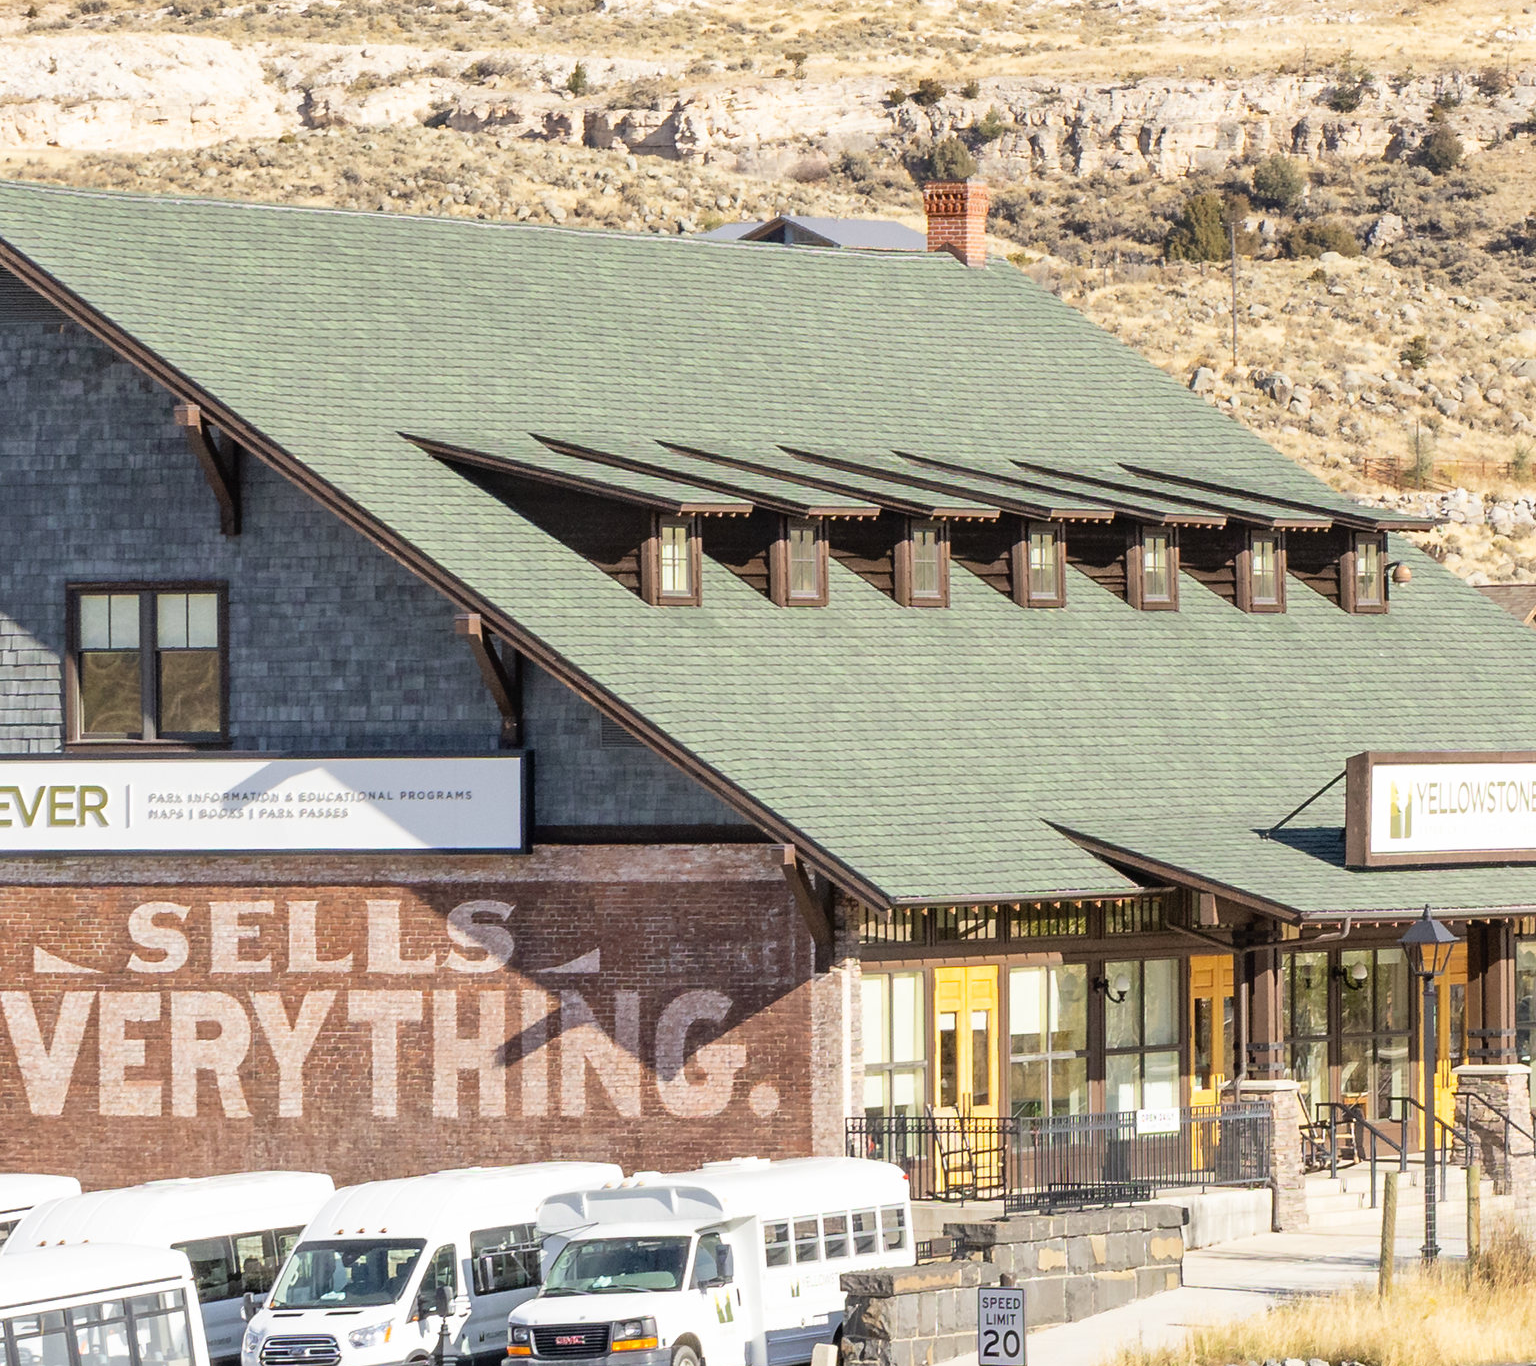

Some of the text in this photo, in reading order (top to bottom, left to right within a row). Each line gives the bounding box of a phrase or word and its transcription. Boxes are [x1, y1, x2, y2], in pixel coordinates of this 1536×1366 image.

[148, 792, 182, 803] PARK
[187, 791, 279, 803] INFORMATION
[298, 791, 394, 802] EDUCATIONAL
[399, 791, 473, 801] PROGRAMS
[148, 808, 349, 819] MAPS BOOKS PARK PASSES
[126, 899, 516, 974] SELLS
[982, 1297, 1021, 1309] SPEED
[986, 1313, 1016, 1325] LIMIT
[555, 1335, 585, 1345] GMC
[983, 1329, 1020, 1358] 20
